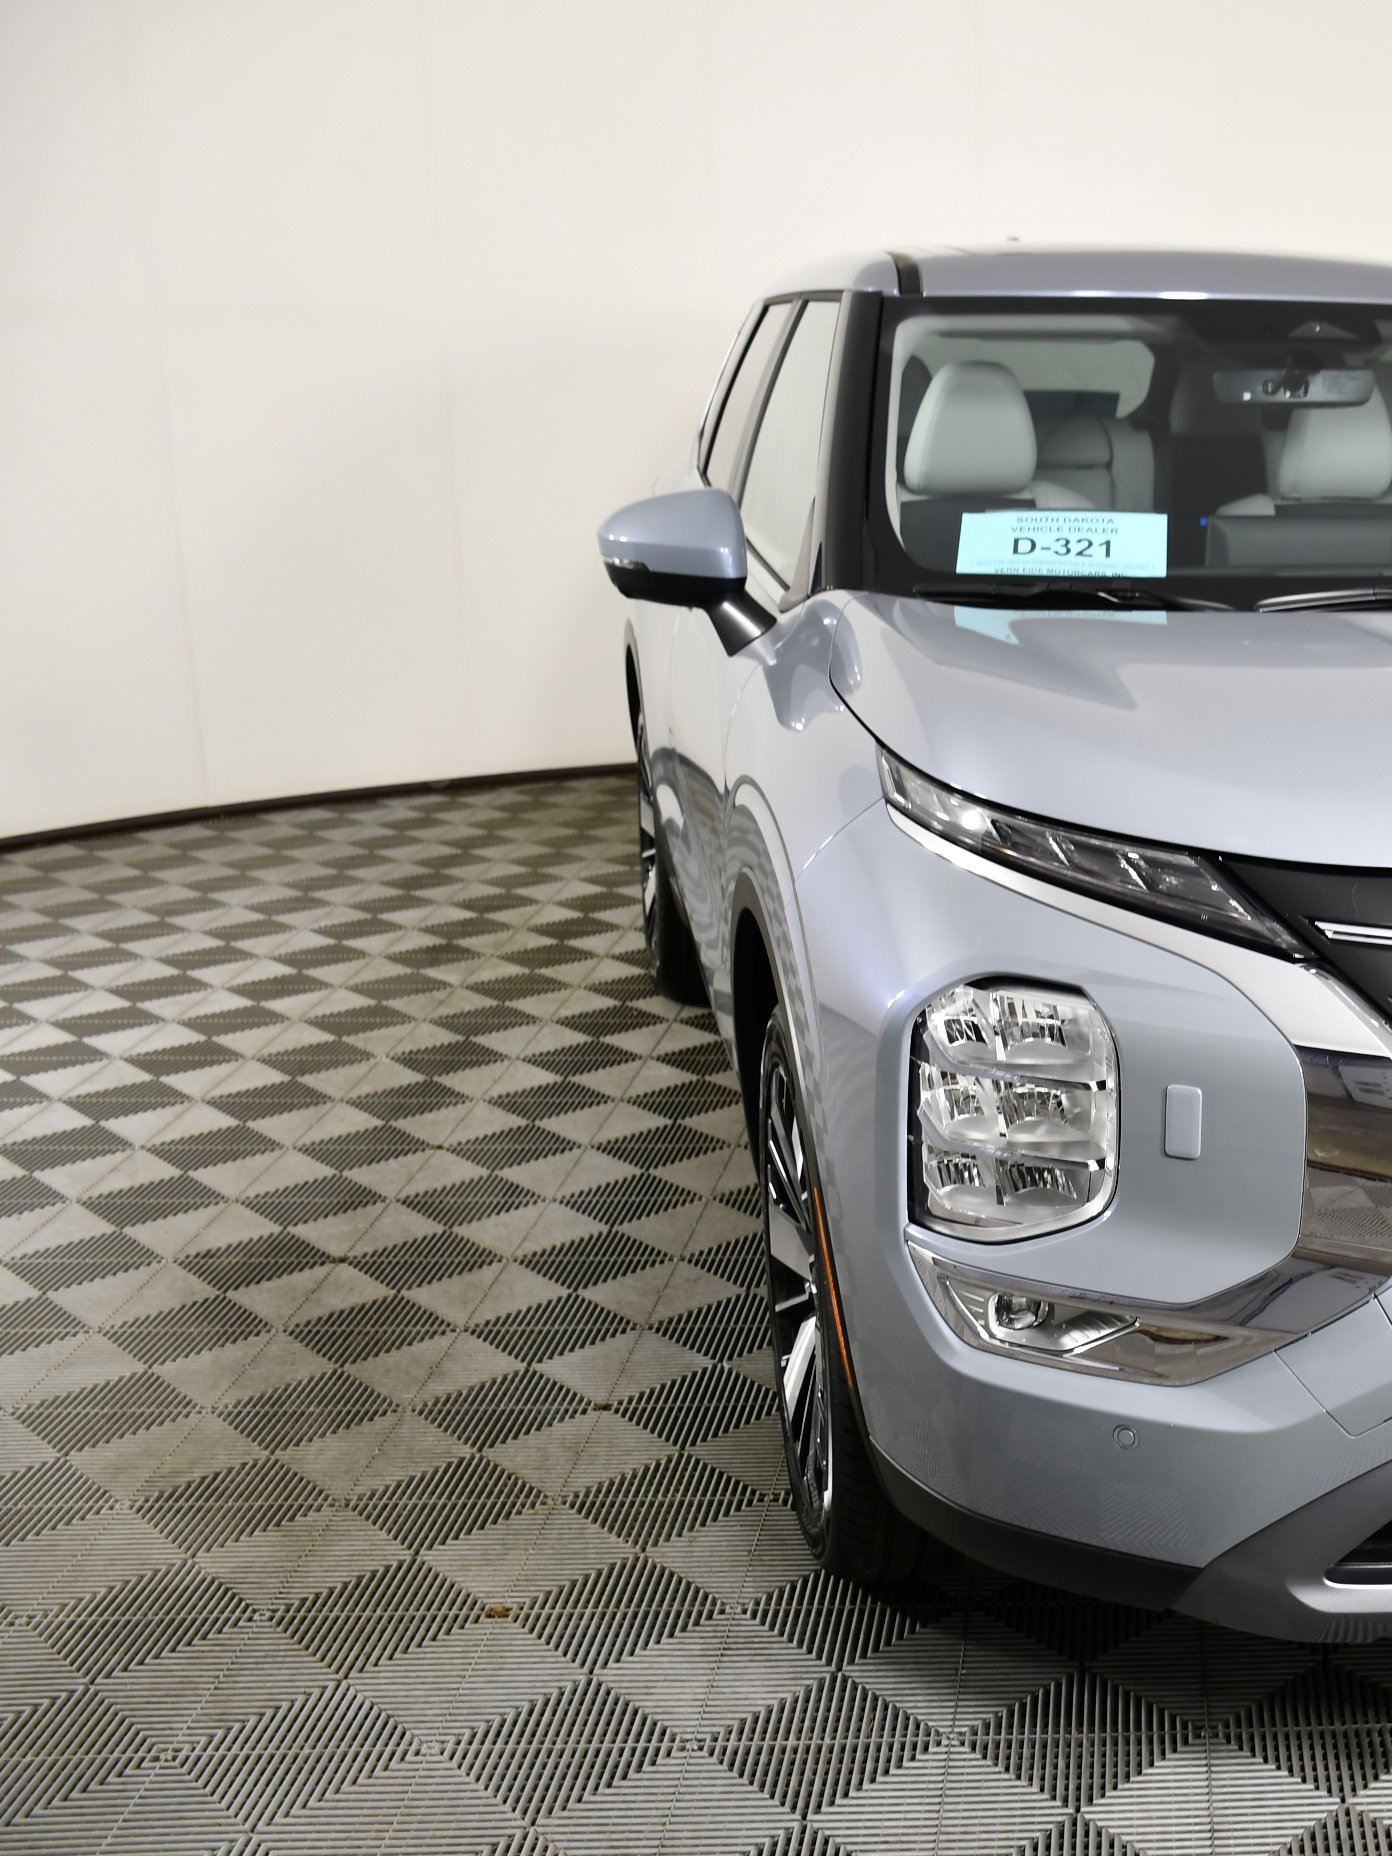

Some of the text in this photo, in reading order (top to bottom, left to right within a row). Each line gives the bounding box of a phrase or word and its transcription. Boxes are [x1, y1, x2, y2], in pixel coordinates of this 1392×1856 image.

[1016, 516, 1115, 525] SOUTH DAKOTA
[1011, 525, 1119, 535] VEHICLE DEALER
[1012, 537, 1112, 558] D-321
